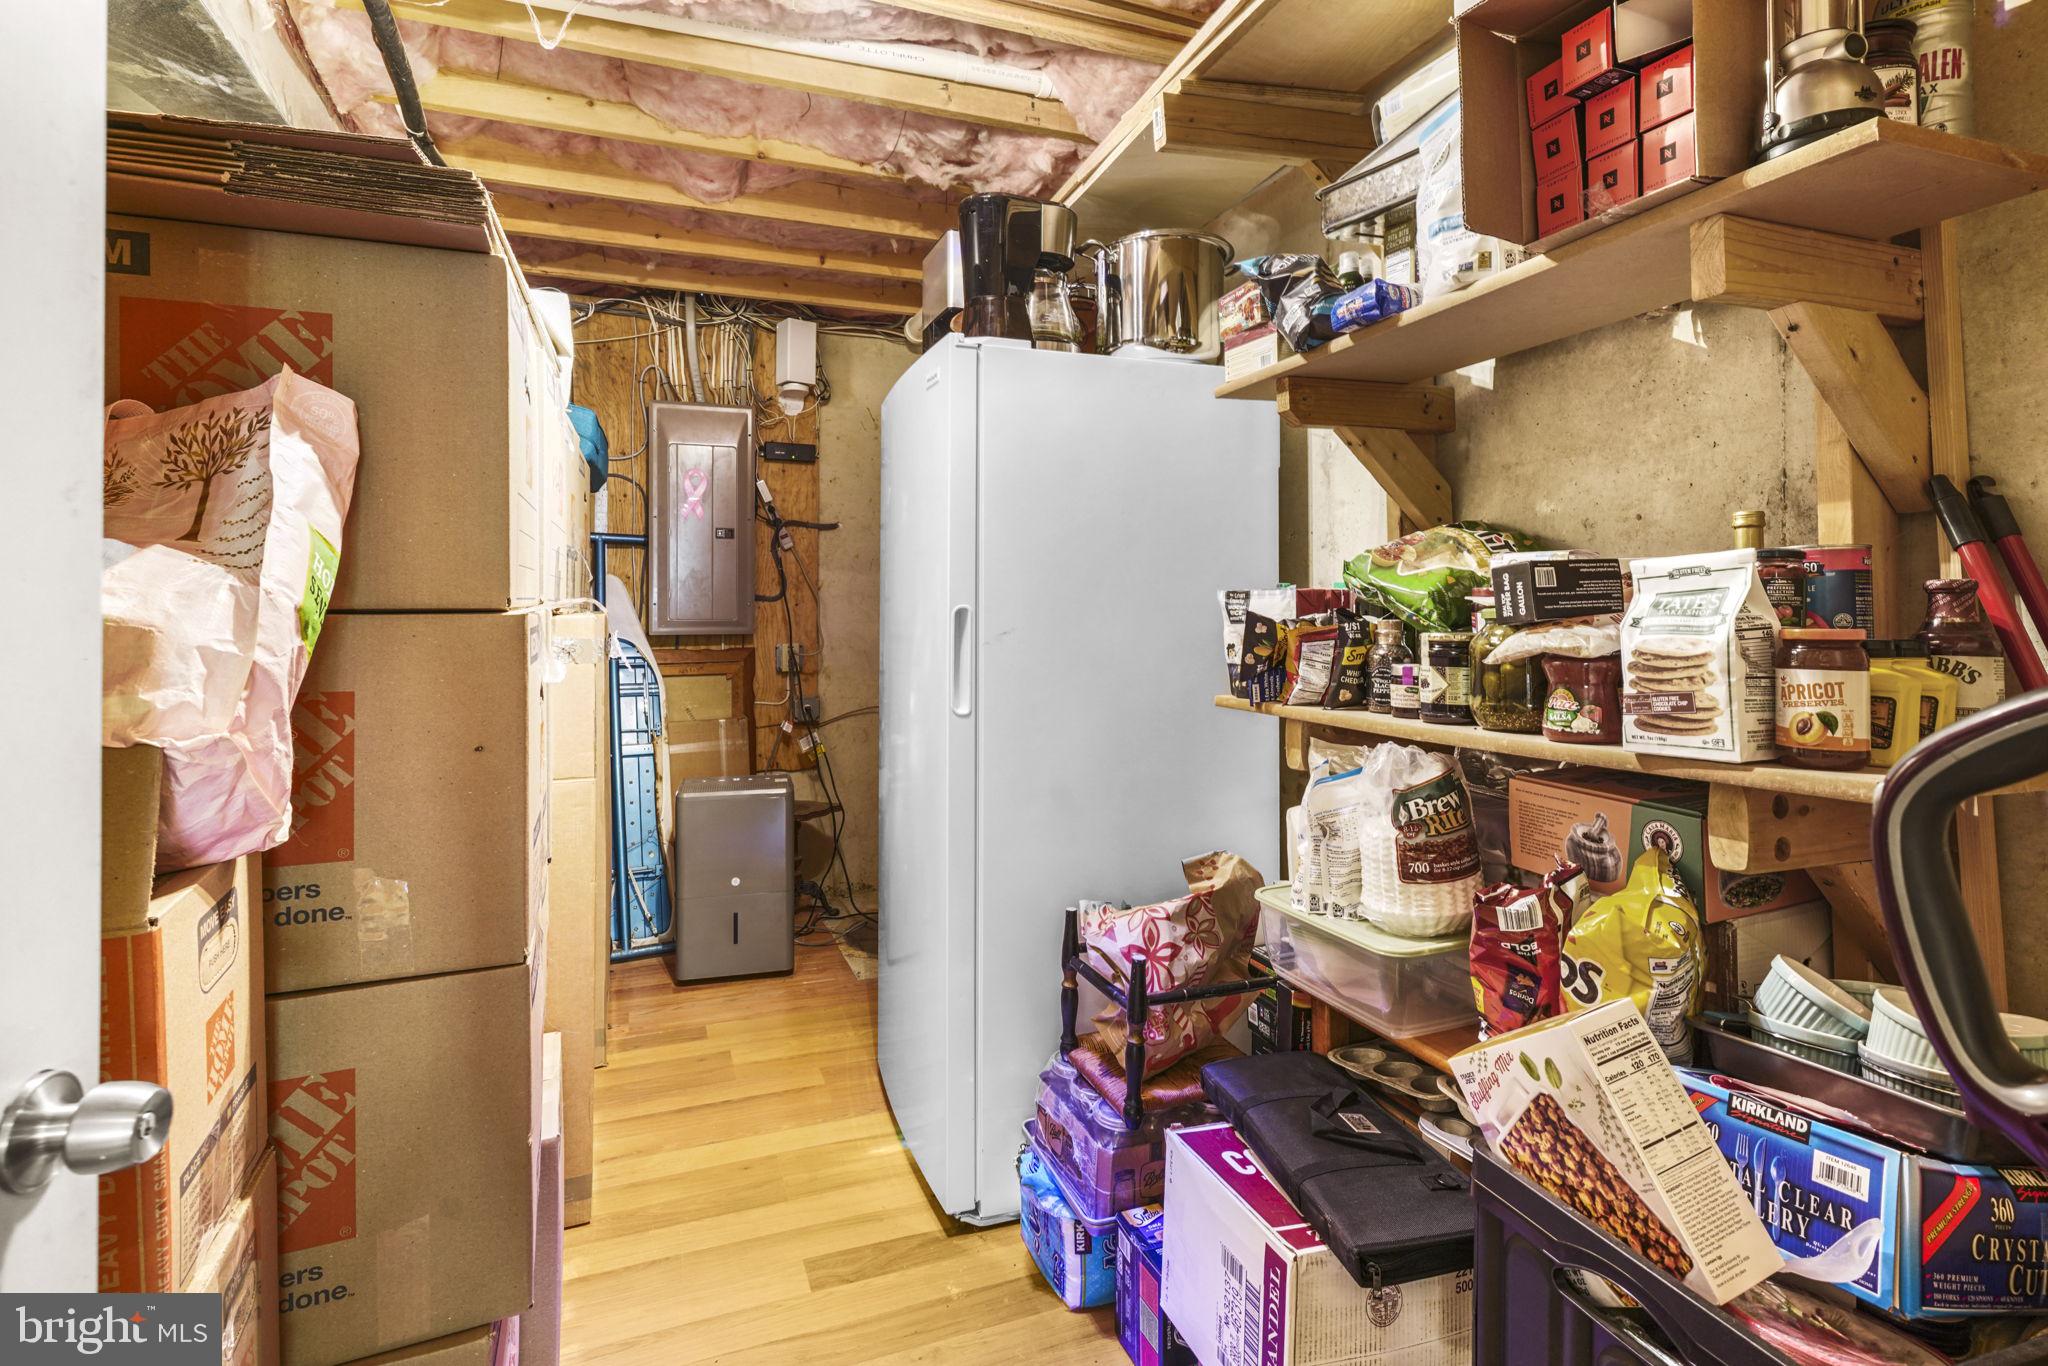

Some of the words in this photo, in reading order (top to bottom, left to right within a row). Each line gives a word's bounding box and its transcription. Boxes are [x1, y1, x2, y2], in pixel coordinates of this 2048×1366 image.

[1896, 8, 1907, 17] NO
[1919, 48, 1962, 83] ALEN
[141, 320, 233, 390] THE
[1502, 573, 1510, 591] BAG
[1504, 591, 1513, 617] ZIPPER
[1516, 581, 1526, 616] GALLON
[1657, 591, 1724, 610] TATE'S
[1930, 655, 1983, 686] BB'S
[1781, 681, 1845, 700] APRICOT
[1406, 789, 1462, 821] Brew
[1425, 809, 1467, 836] Rite
[1646, 823, 1659, 835] CASA
[1660, 823, 1678, 841] MARIA
[1408, 862, 1430, 873] 700
[201, 909, 220, 942] MOVE
[1500, 942, 1538, 952] BOLD
[1508, 988, 1535, 1005] Doritos
[1655, 1000, 1681, 1008] Calories
[1583, 1025, 1619, 1046] Nutrition
[1618, 1017, 1640, 1032] Facts
[1460, 1071, 1475, 1080] TRADER
[1604, 1070, 1627, 1083] Calories
[1631, 1060, 1645, 1070] 120
[1647, 1052, 1660, 1063] 170
[1465, 1077, 1476, 1085] JOE'S
[1469, 1071, 1501, 1114] Stuffing
[1494, 1050, 1514, 1075] Mix
[1731, 1096, 1808, 1133] KIRKLAND
[1825, 1154, 1841, 1165] ITEM
[1998, 1169, 2048, 1187] KIRKL
[1777, 1180, 1853, 1230] CLEAR
[1990, 1197, 2015, 1223] 360
[156, 1199, 170, 1242] DUTY
[1926, 1211, 1953, 1244] PREMIUM
[1076, 1223, 1085, 1252] KIRK
[1933, 1272, 1945, 1280] 360
[1947, 1273, 1979, 1283] PREMIUM
[1933, 1281, 1961, 1290] WEIGHT
[1963, 1283, 1986, 1292] PIECES
[1266, 1266, 1281, 1366] ANDEL
